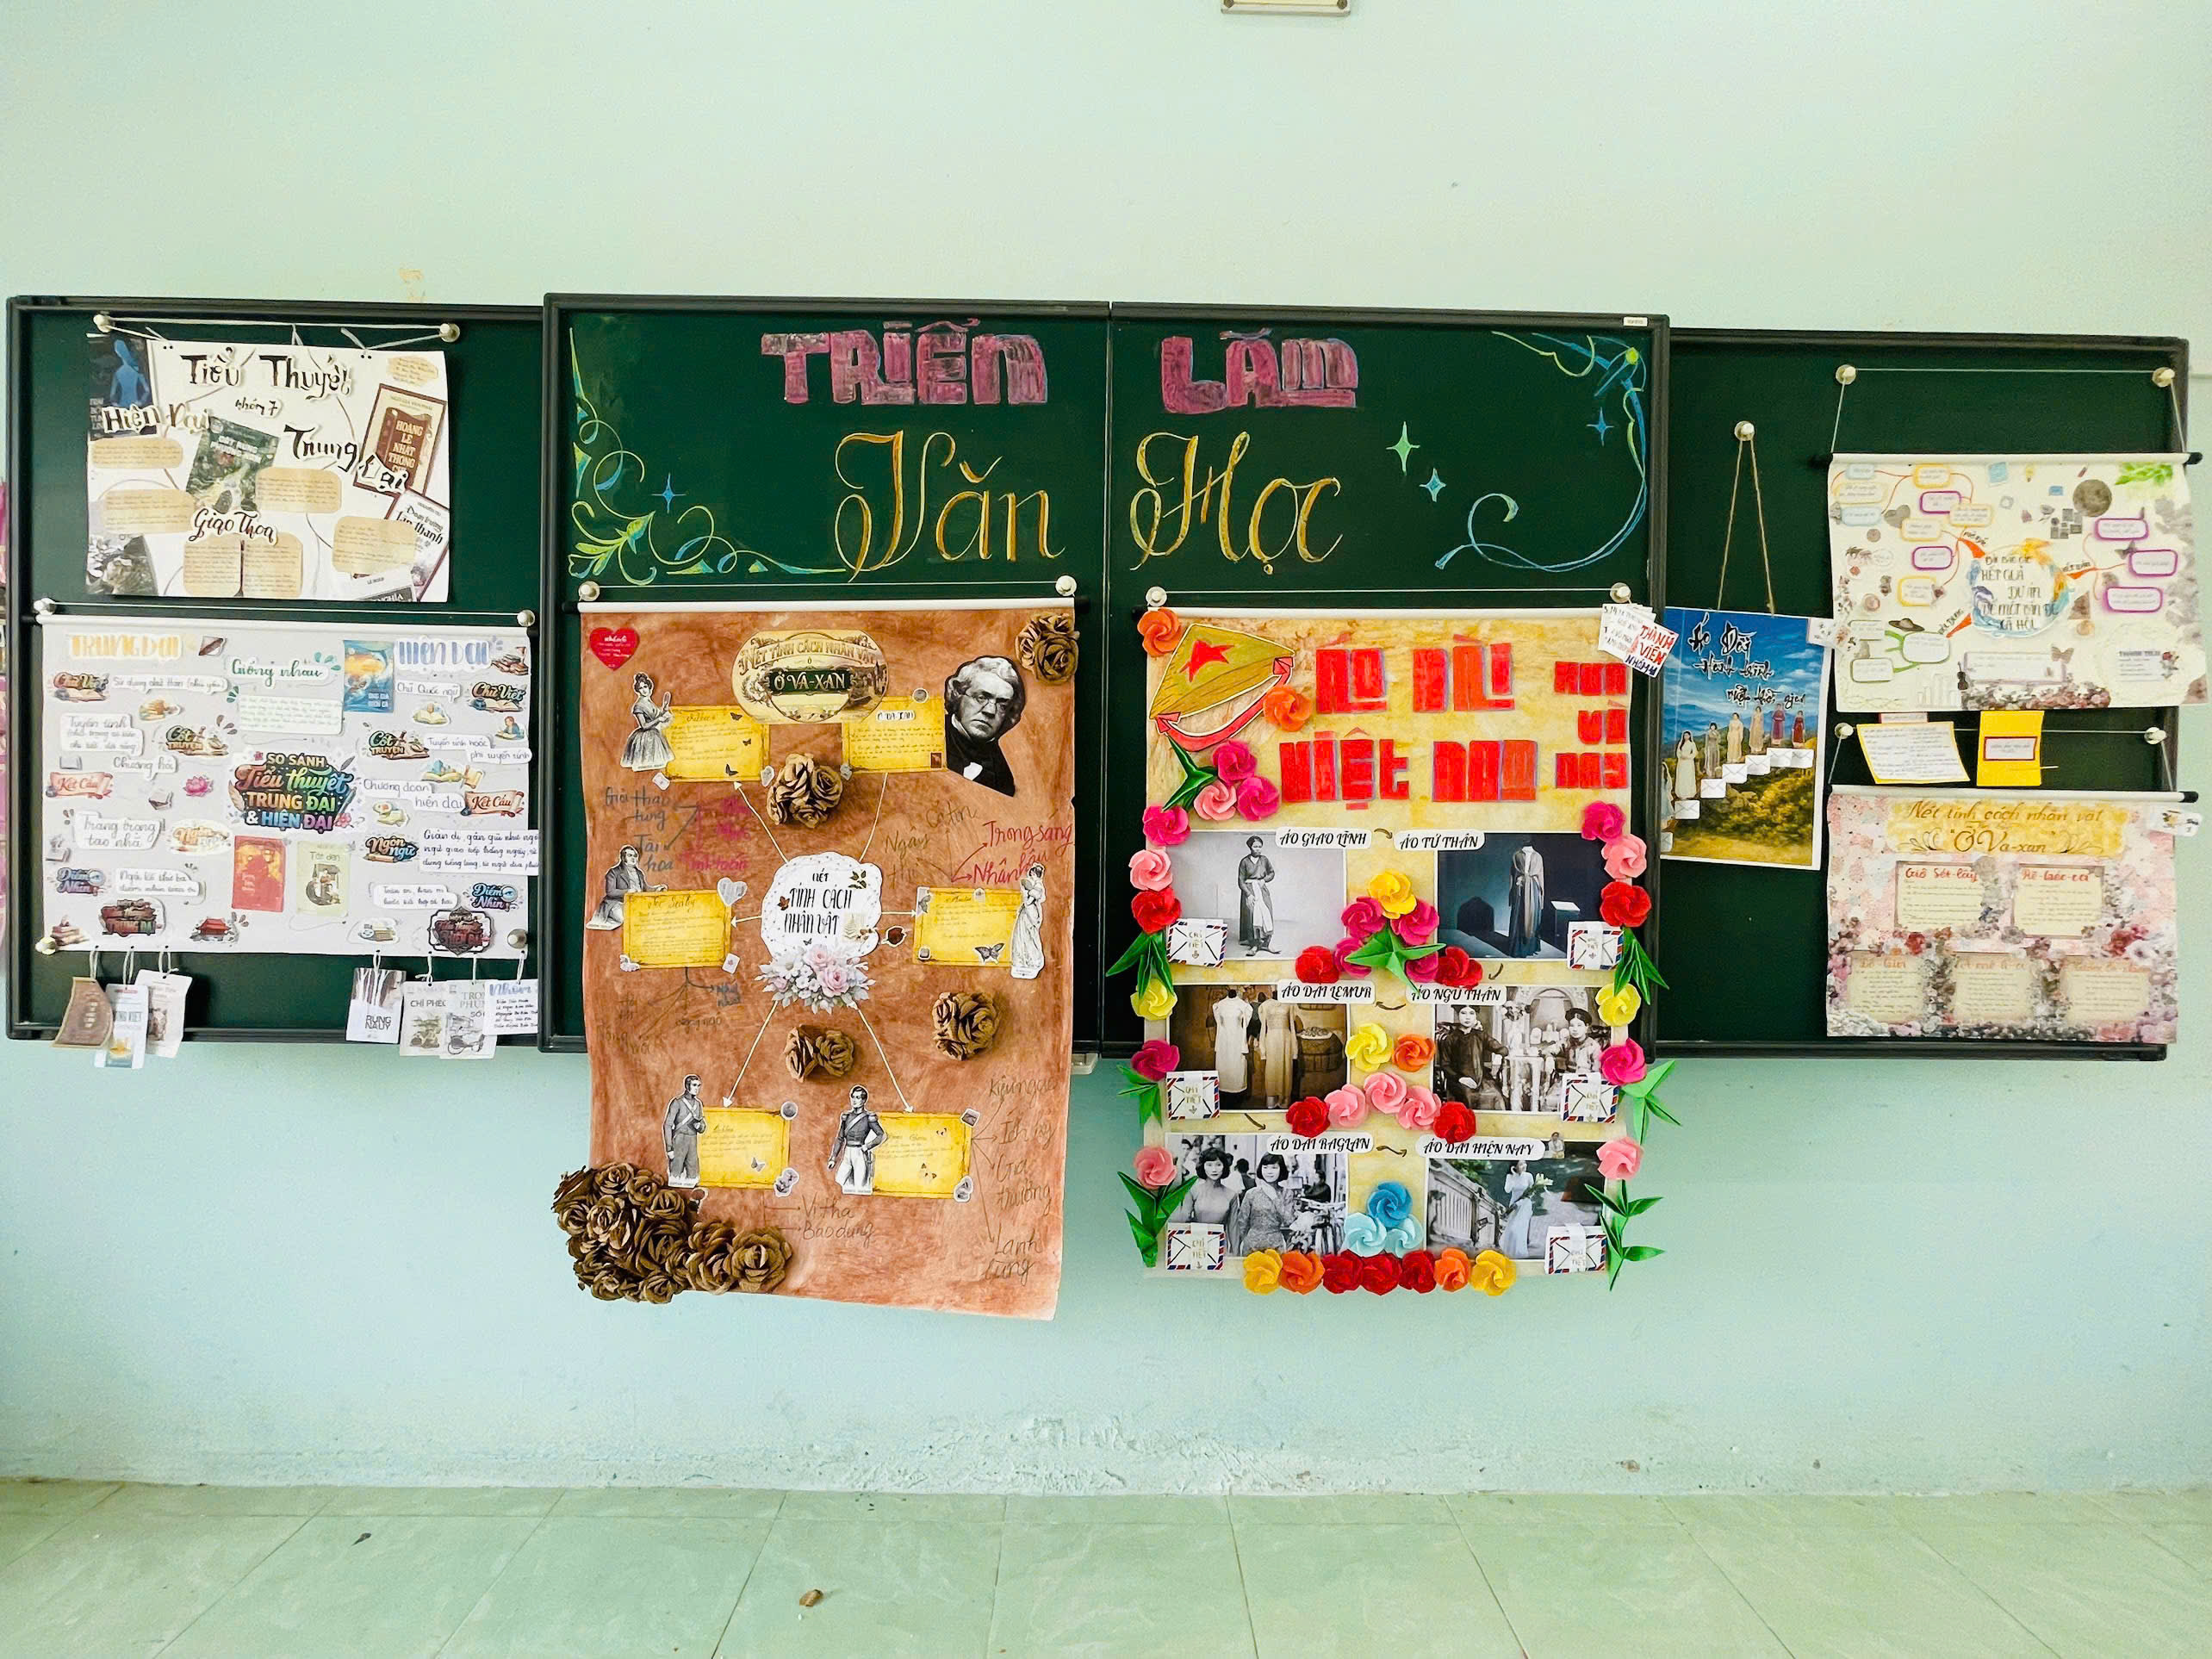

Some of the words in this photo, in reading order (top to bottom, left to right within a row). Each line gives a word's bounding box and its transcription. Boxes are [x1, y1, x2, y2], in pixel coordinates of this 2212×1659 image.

[761, 318, 1048, 405] TRIỂN
[1161, 327, 1358, 414] LÃM
[246, 792, 303, 810] TRUNG
[1302, 832, 1334, 848] GIAO
[1442, 834, 1478, 849] THÂN
